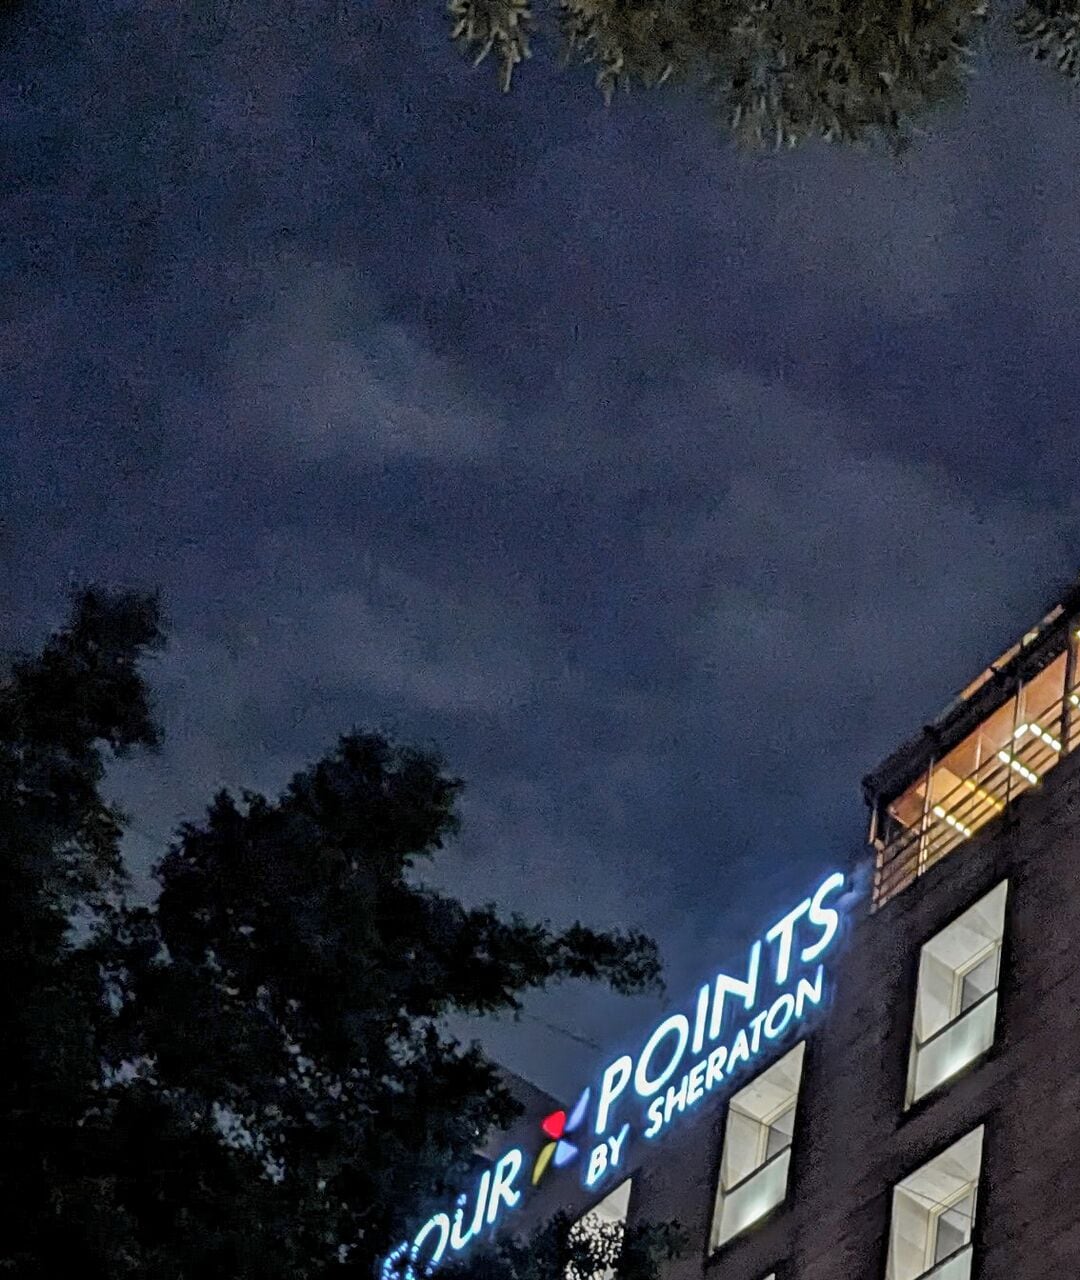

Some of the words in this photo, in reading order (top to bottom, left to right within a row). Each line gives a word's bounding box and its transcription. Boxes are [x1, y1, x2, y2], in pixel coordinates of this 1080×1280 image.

[585, 1124, 630, 1188] BY
[644, 963, 826, 1140] SHERATON
[595, 871, 846, 1137] POINTS
